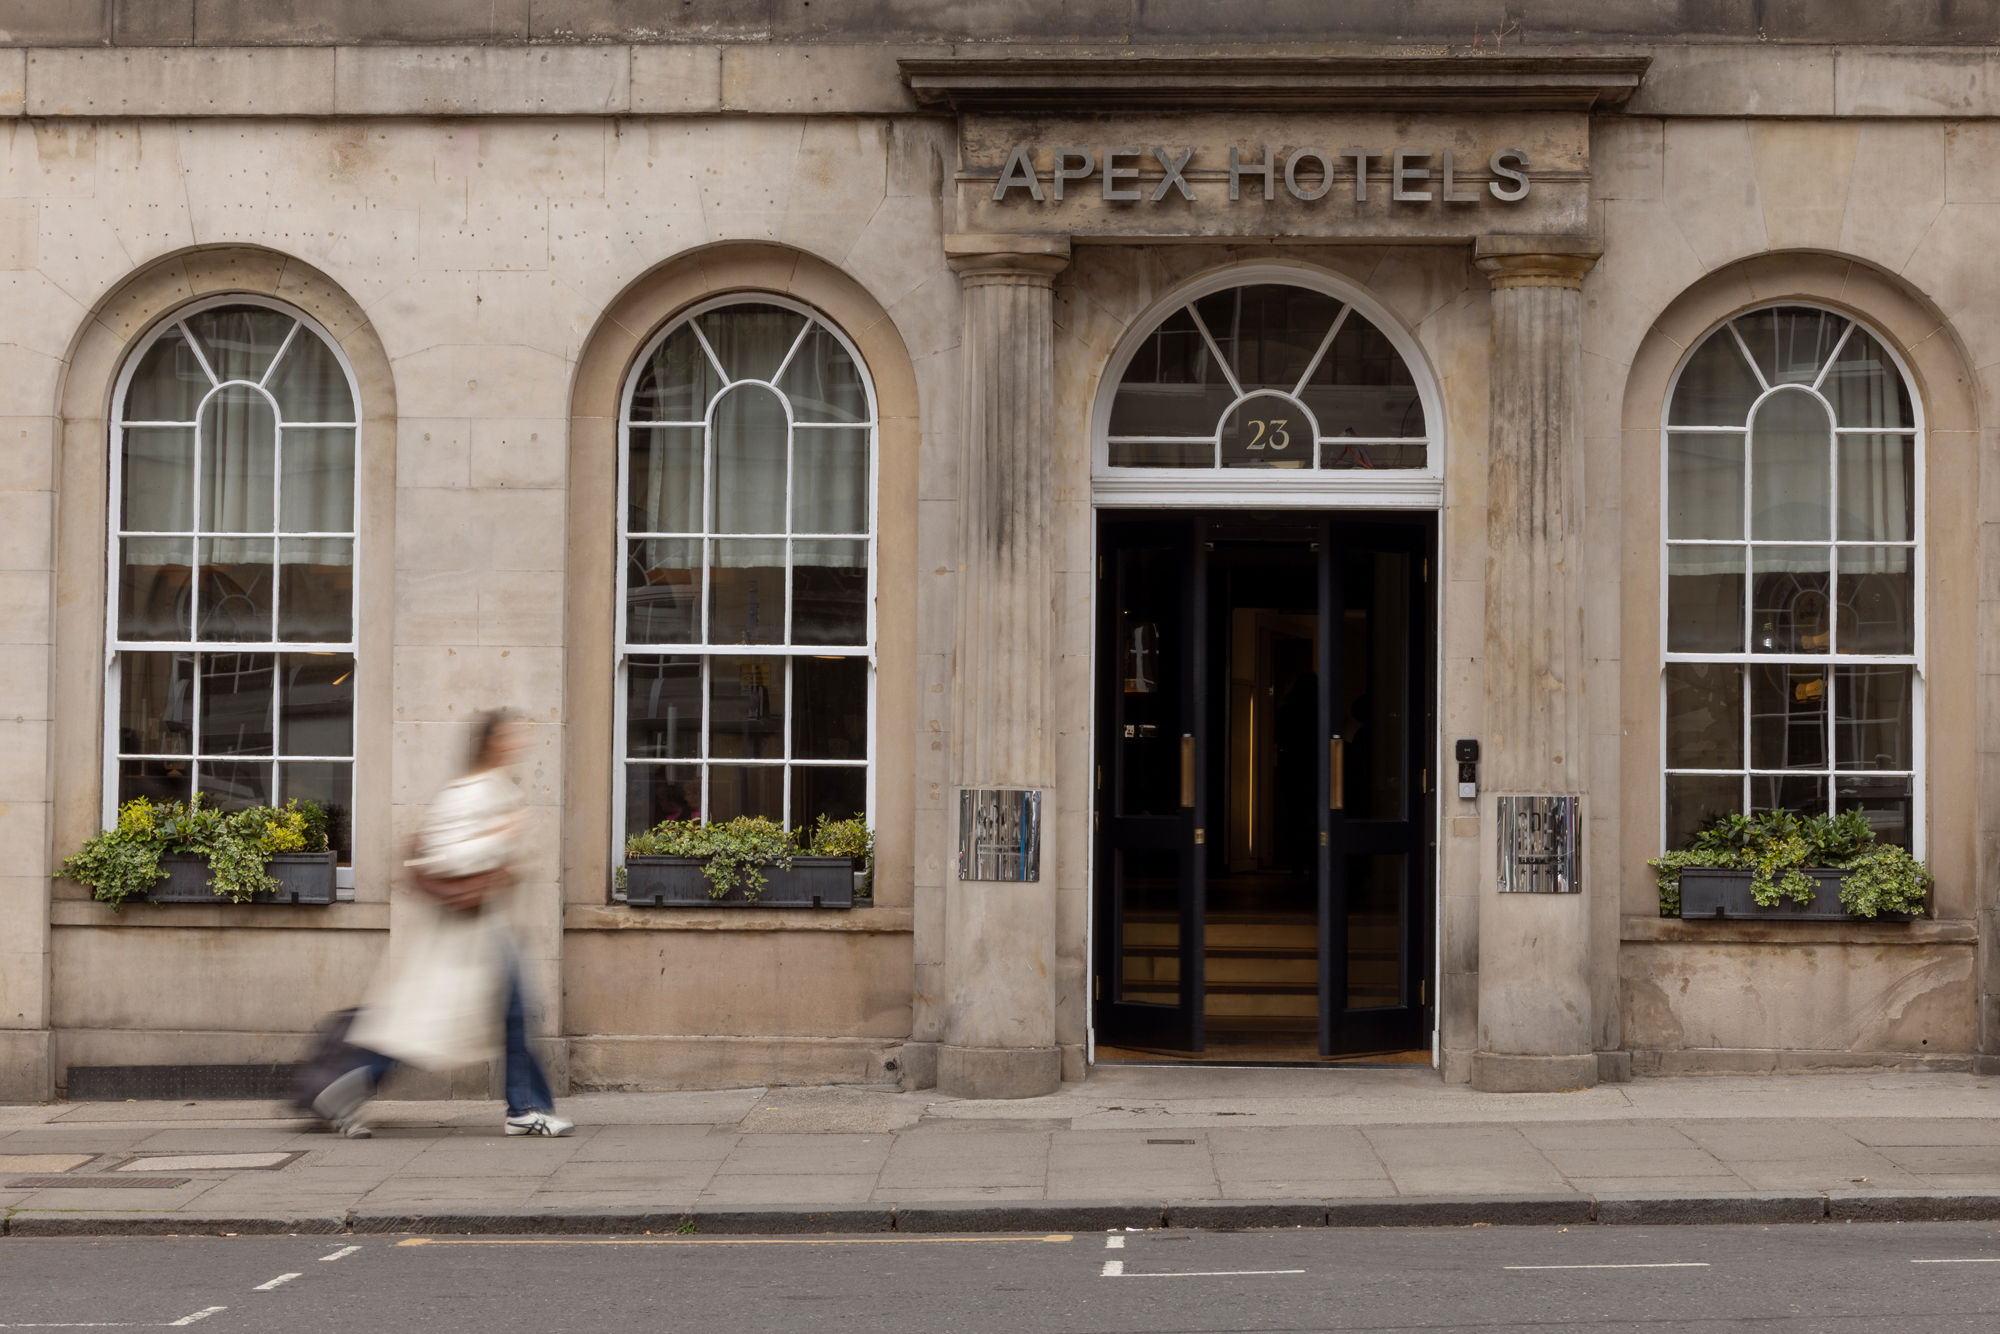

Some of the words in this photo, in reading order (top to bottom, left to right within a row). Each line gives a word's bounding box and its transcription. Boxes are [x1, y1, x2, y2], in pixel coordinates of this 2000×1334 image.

[992, 147, 1197, 201] APEX
[1229, 147, 1531, 201] HOTELS
[1246, 420, 1289, 450] 23
